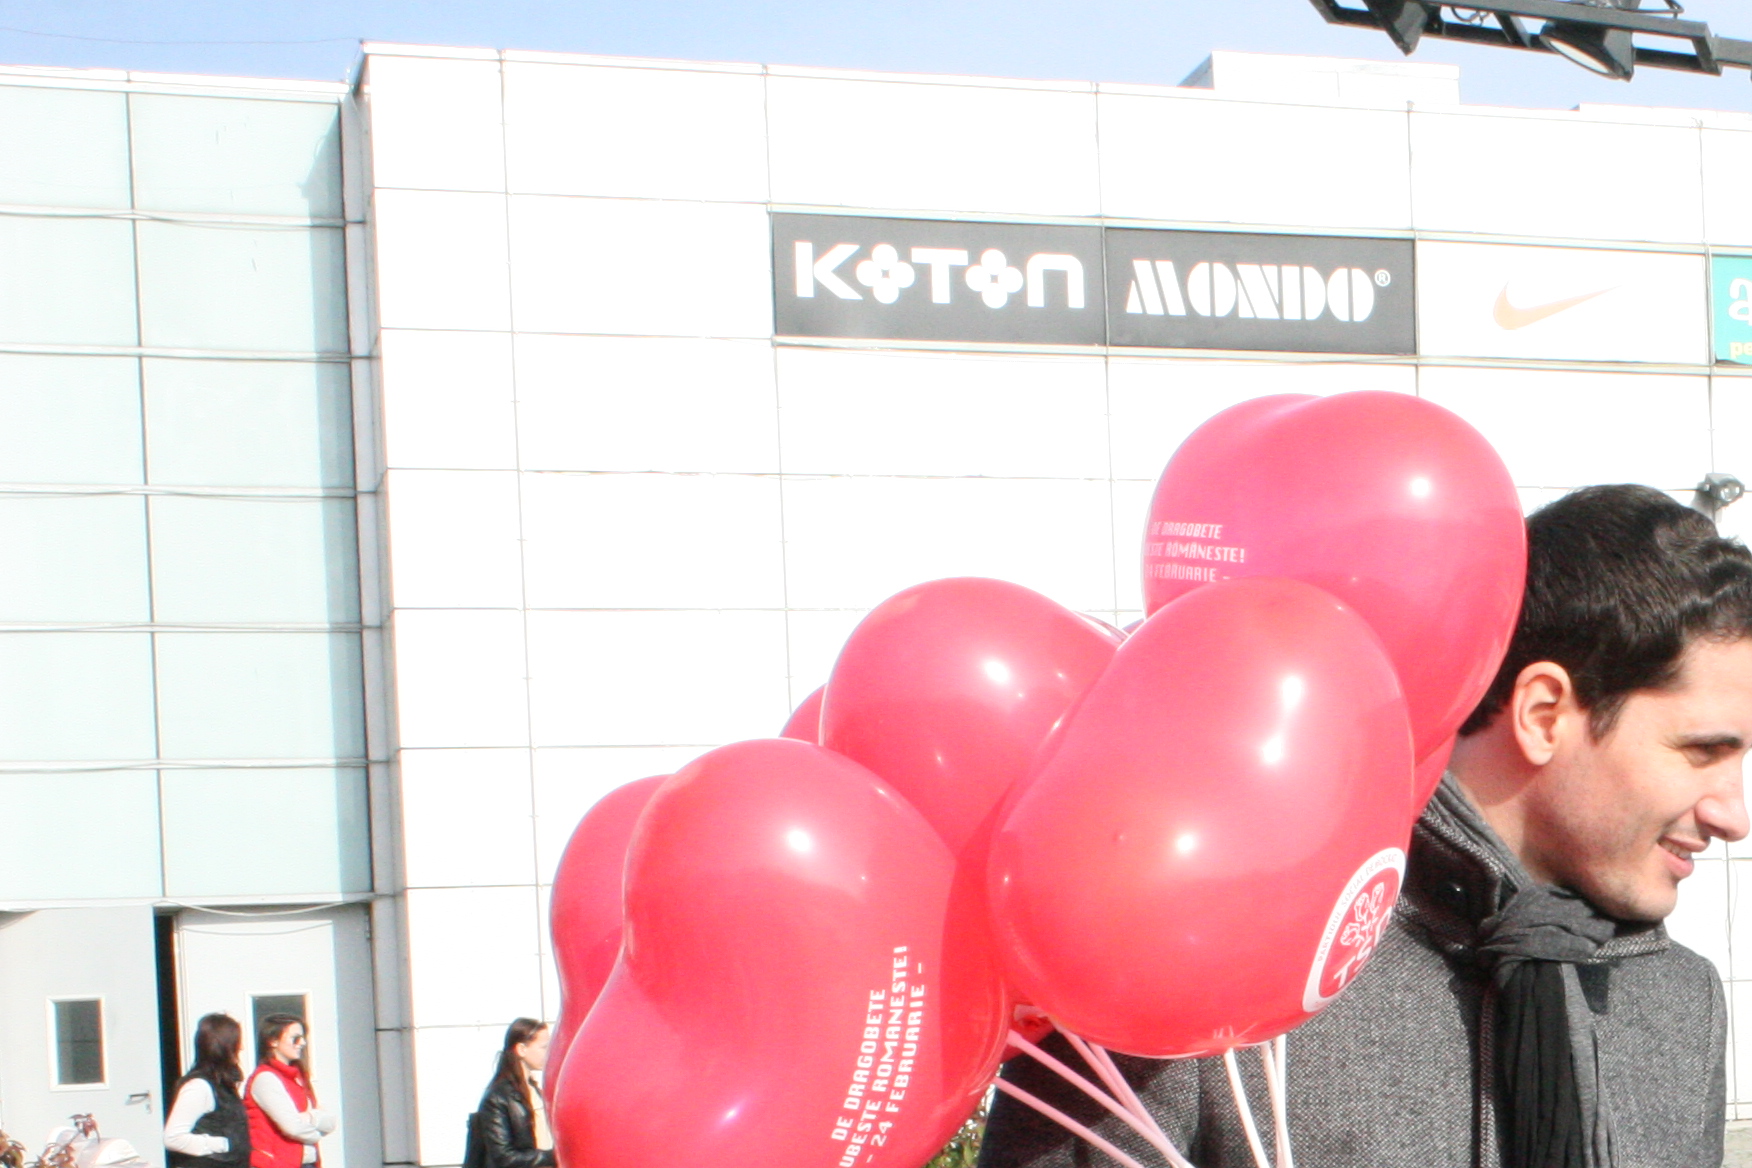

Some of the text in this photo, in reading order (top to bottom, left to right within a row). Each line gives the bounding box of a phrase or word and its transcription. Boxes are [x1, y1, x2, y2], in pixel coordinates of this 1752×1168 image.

[831, 988, 886, 1142] DE DRAGOBETE
[870, 1120, 894, 1148] 24
[885, 983, 925, 1114] FEBRUARIE
